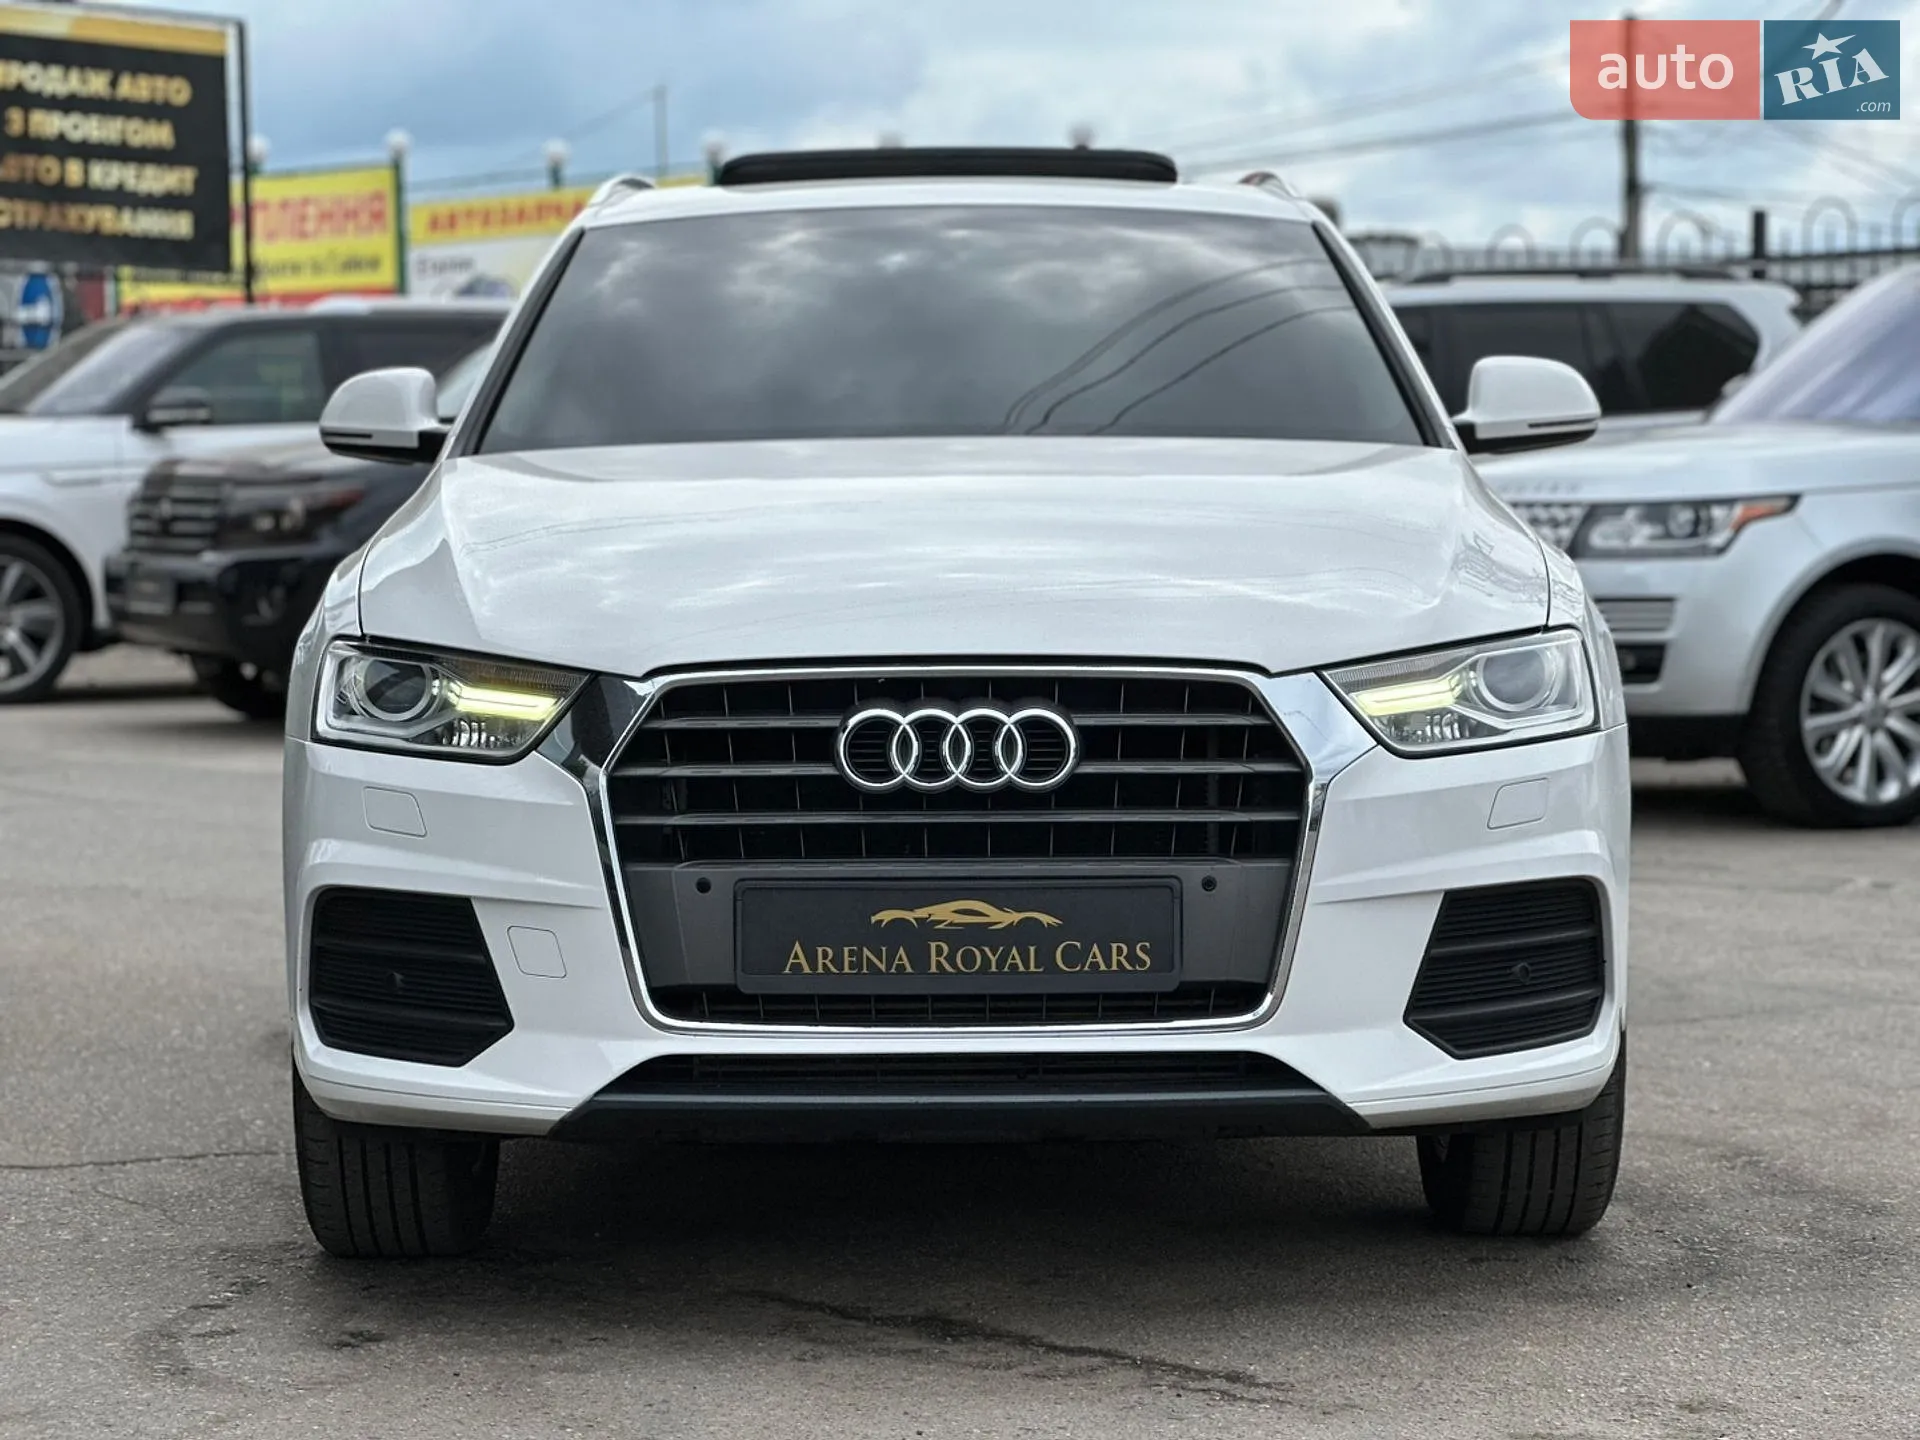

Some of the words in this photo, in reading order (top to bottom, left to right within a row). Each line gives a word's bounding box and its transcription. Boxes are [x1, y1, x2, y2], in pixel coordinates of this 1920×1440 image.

[115, 71, 193, 107] АВТО
[64, 156, 85, 188] В
[88, 158, 198, 197] КРЕДИТ
[783, 940, 915, 974] ARENA
[927, 941, 1044, 973] ROYAL
[1055, 941, 1151, 972] CARS
